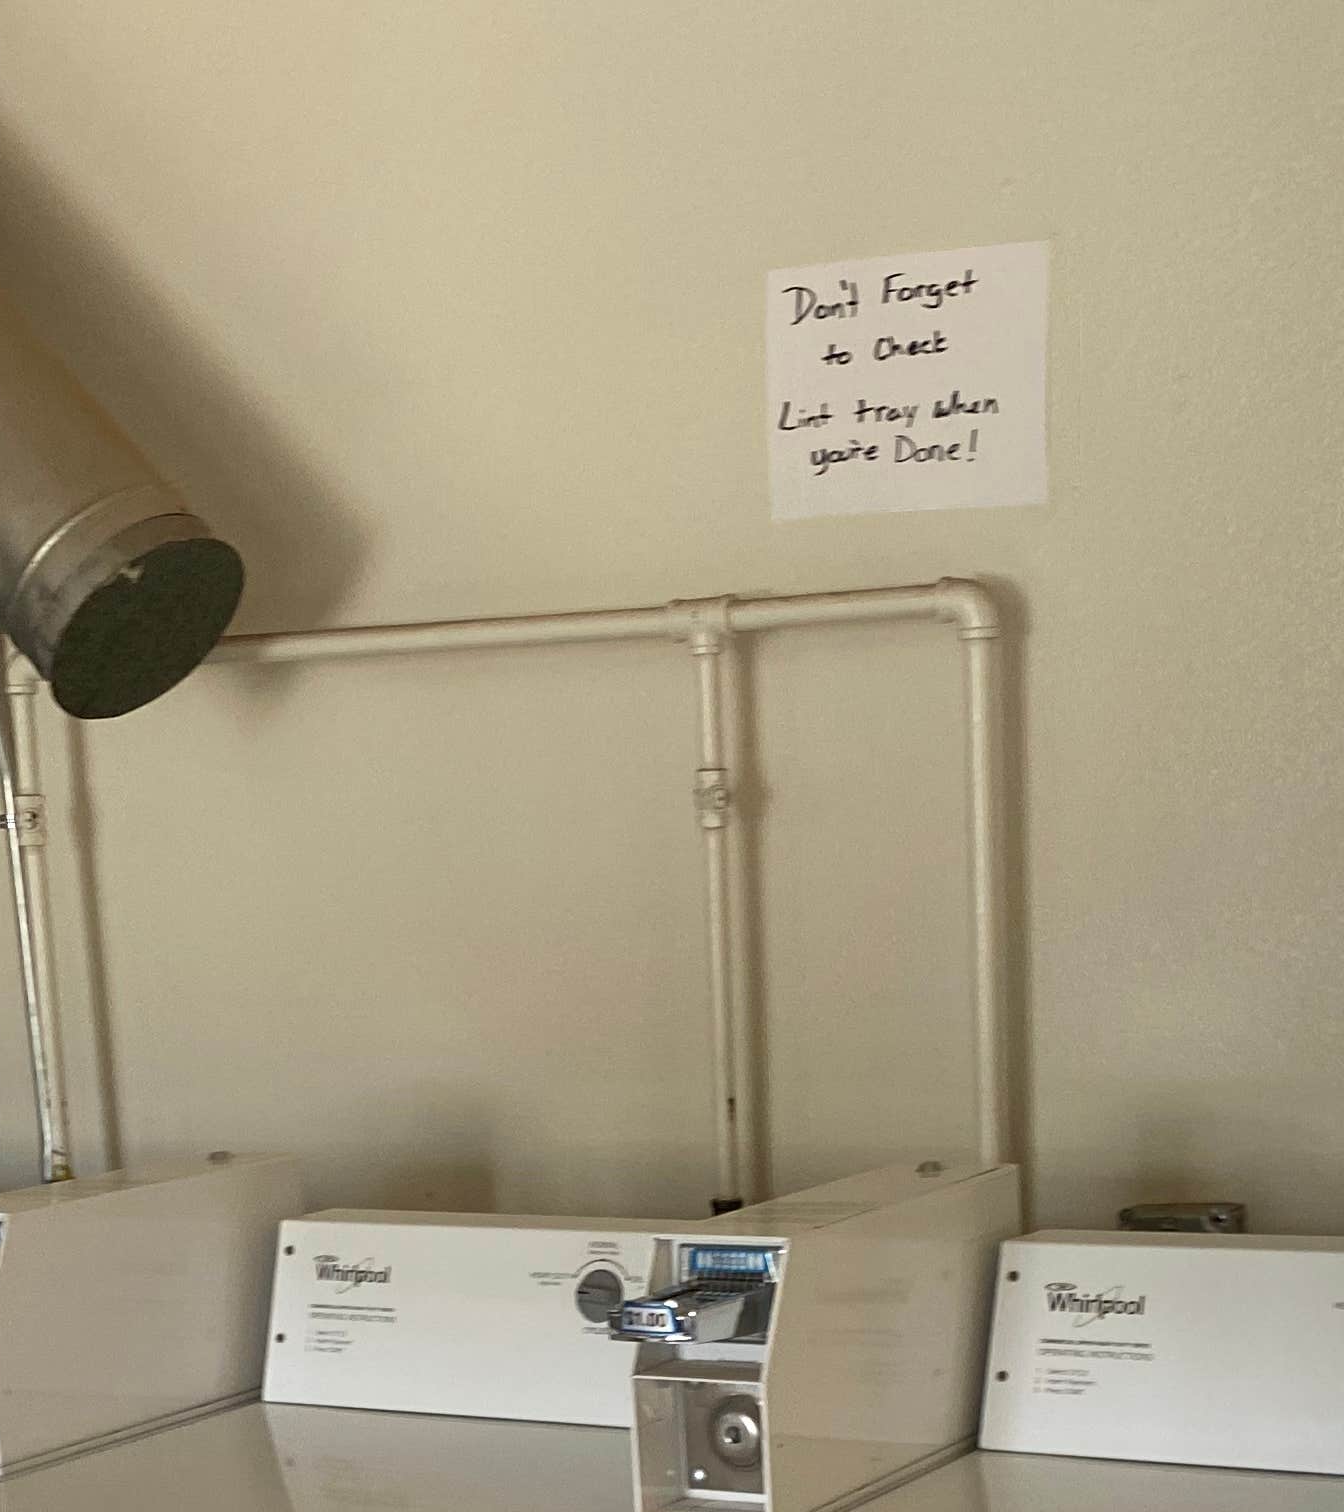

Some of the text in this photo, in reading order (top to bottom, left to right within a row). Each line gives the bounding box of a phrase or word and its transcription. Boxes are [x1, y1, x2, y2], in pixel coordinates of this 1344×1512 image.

[782, 269, 979, 326] Don't Forget
[821, 330, 949, 366] to Check
[778, 390, 1000, 430] Lint tray when
[894, 429, 978, 463] Done!
[1045, 1291, 1147, 1320] Whirlpool
